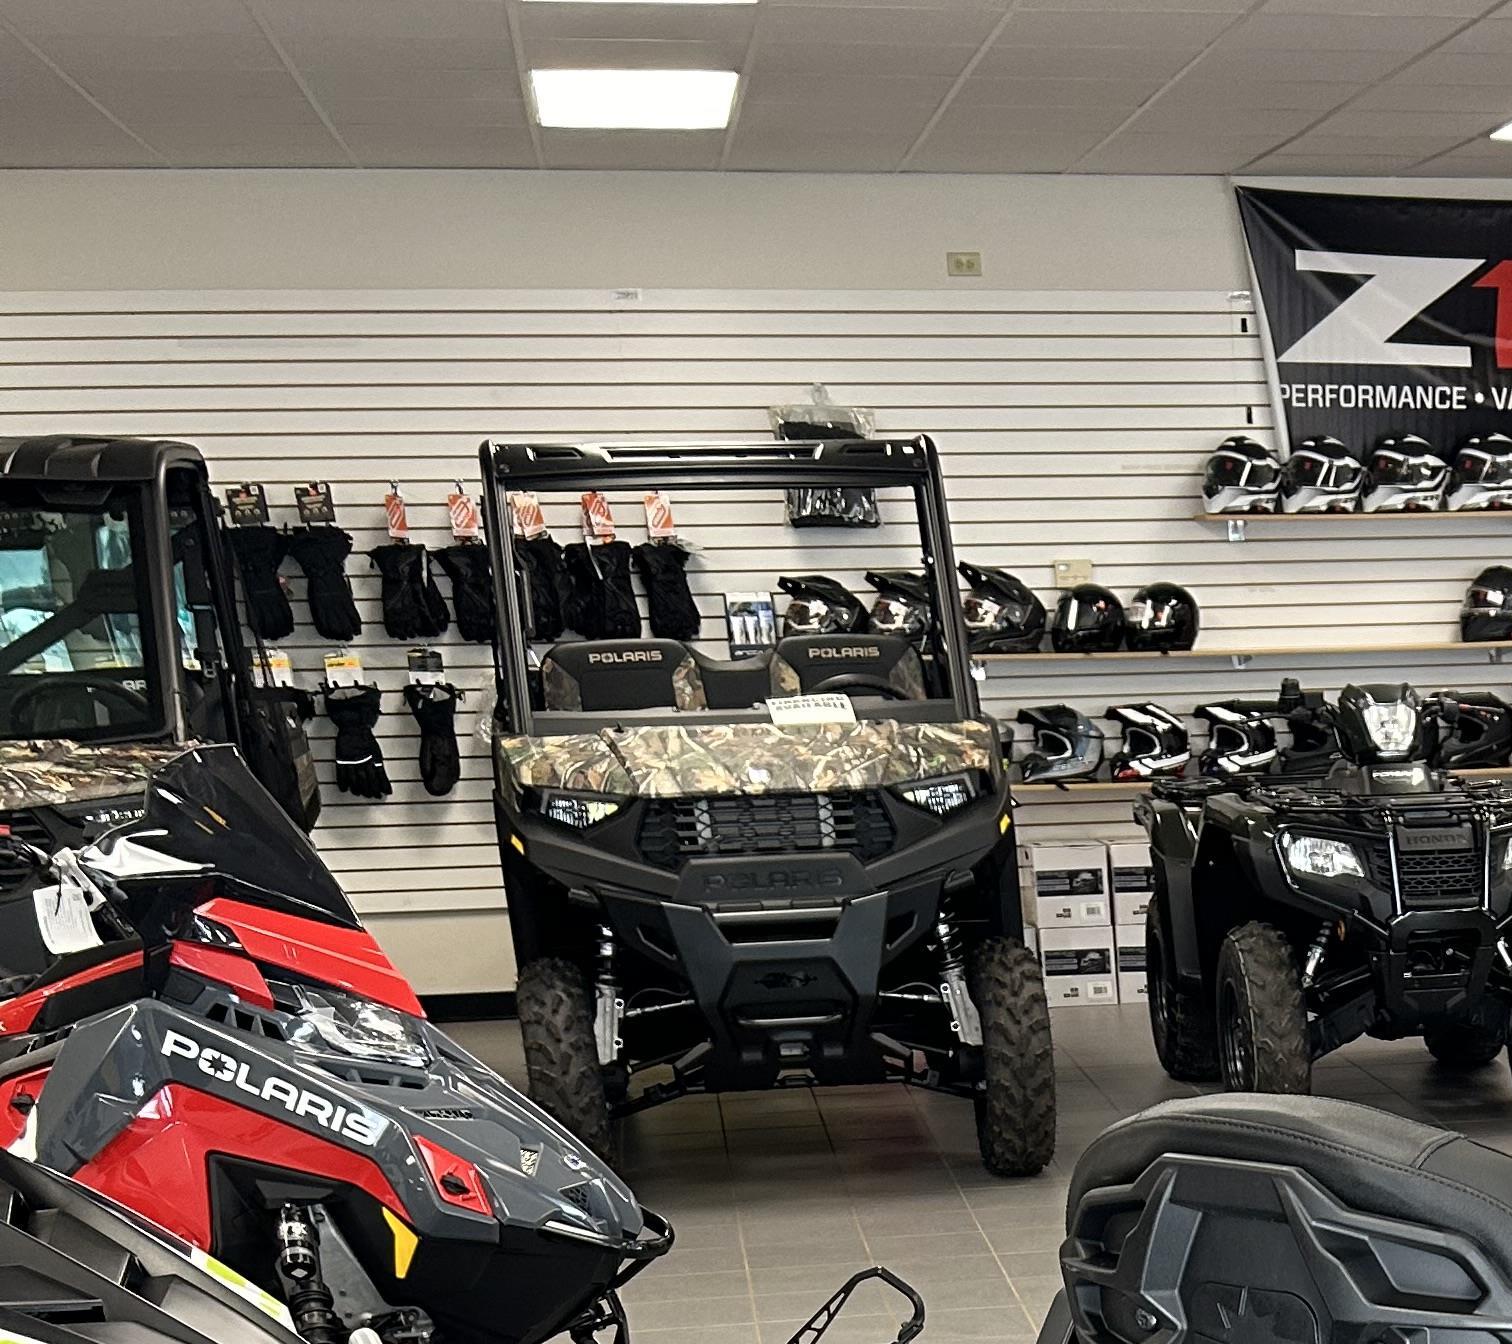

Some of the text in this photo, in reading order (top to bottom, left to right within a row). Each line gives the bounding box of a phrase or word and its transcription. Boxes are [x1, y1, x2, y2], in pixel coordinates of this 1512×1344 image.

[1280, 384, 1467, 410] PERFORMANCE
[588, 650, 663, 664] POLARIS
[808, 646, 880, 659] POLARIS
[161, 1029, 390, 1147] POLARIS
